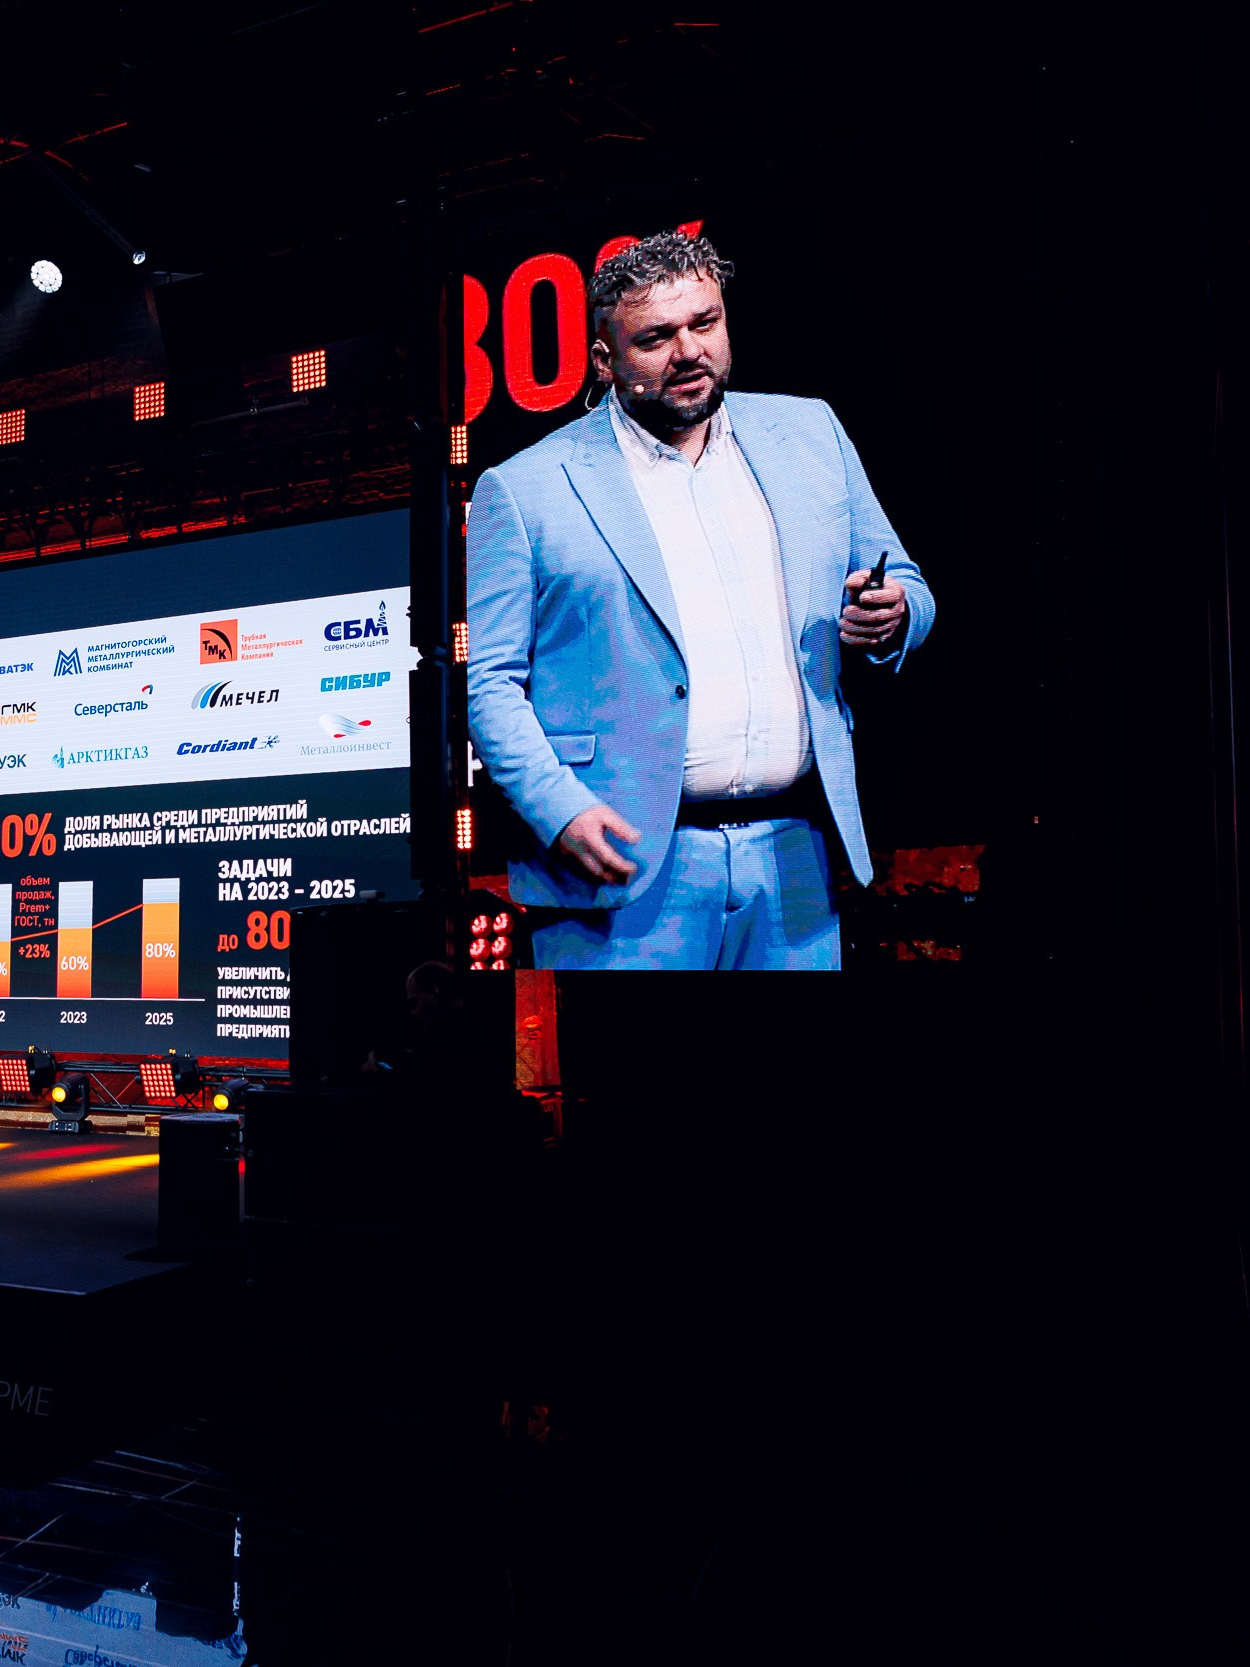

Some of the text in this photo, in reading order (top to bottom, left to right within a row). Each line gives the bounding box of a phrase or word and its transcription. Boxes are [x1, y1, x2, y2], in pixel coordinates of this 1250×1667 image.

[324, 618, 389, 641] СБМ
[88, 635, 167, 652] МАГНИТОГОРСКИЙ
[241, 633, 266, 643] Трубная
[241, 638, 303, 651] Металлургическая
[324, 639, 389, 652] СЕРВИСНЫЙ ЦЕНТР
[88, 645, 175, 663] МЕТАЛЛУРГИЧЕСКИЙ
[241, 651, 274, 661] Компания
[88, 662, 133, 673] КОМБИНАТ
[321, 672, 390, 692] СИБУР
[220, 689, 279, 707] МЕЧЕЛ
[74, 700, 148, 717] Северсталь
[177, 737, 257, 755] Cordiant
[301, 741, 392, 756] Металлоинвест
[67, 746, 148, 764] АРКТИКГАЗ
[64, 800, 307, 833] ДОЛЯ РЫНКА СРЕДИ ПРЕДПРИЯТИЙ
[64, 813, 411, 851] ДОБЫВАЮЩЕЙ И МЕТАЛЛУРГИЧЕСКОЙ ОТРАСЛЕЙ
[218, 858, 292, 880] ЗАДАЧИ
[20, 876, 50, 885] объем
[16, 890, 55, 900] продаж,
[219, 882, 243, 901] НА
[248, 881, 289, 900] 2023
[310, 879, 355, 899] 2025
[20, 903, 50, 912] Prem+
[14, 916, 54, 927] ГОСТ, тн
[19, 944, 50, 958] +23%
[145, 943, 176, 958] 80%
[61, 956, 89, 970] 60%
[217, 967, 285, 979] УВЕЛИЧИТЬ
[60, 1012, 87, 1023] 2023
[145, 1013, 174, 1025] 2025
